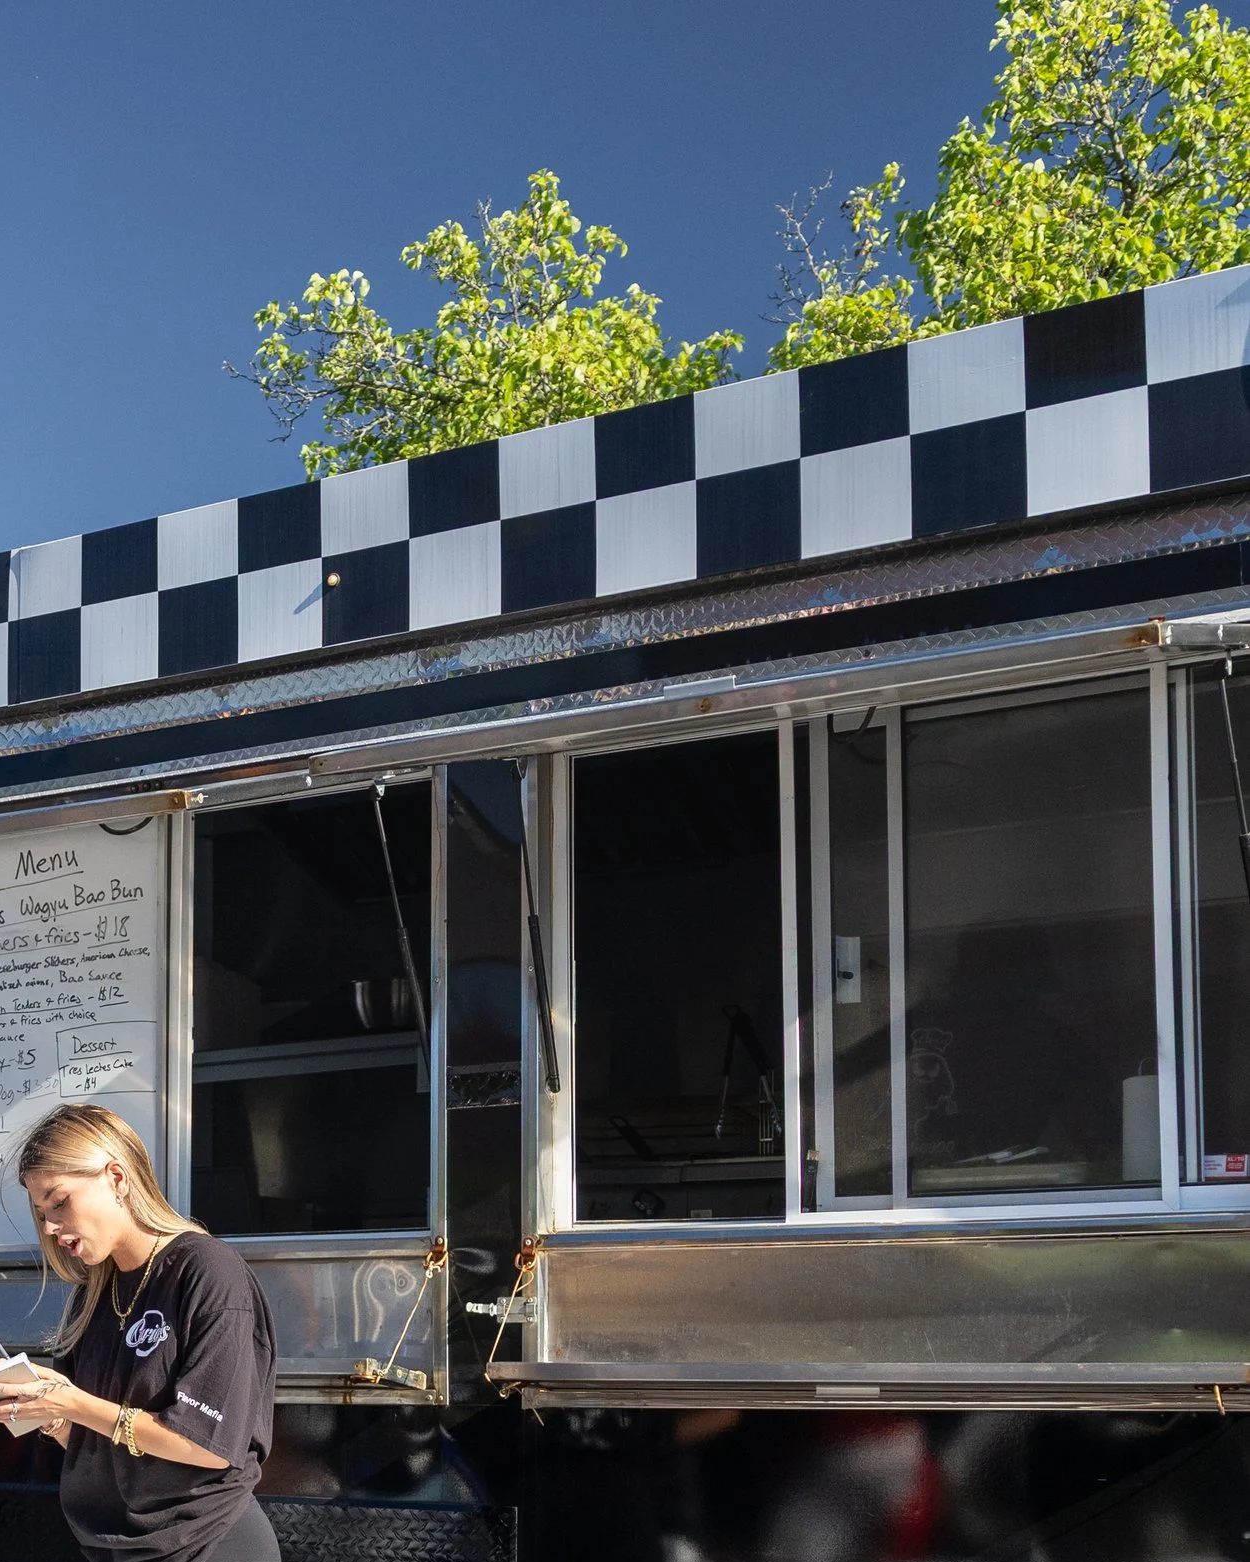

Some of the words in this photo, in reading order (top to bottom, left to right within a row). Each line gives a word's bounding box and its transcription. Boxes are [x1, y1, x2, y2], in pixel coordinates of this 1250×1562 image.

[14, 849, 79, 880] Menu
[20, 895, 69, 923] Wagyu
[73, 883, 106, 906] Bao
[110, 878, 144, 901] Bun
[58, 970, 84, 983] Bao
[12, 998, 41, 1012] Tenders
[46, 1012, 64, 1023] with
[68, 1009, 98, 1022] choice
[71, 1034, 117, 1054] Dessert
[59, 1064, 83, 1078] Tres
[112, 1059, 134, 1069] Cake
[176, 1390, 201, 1408] Flavor
[199, 1402, 224, 1422] Mafia
